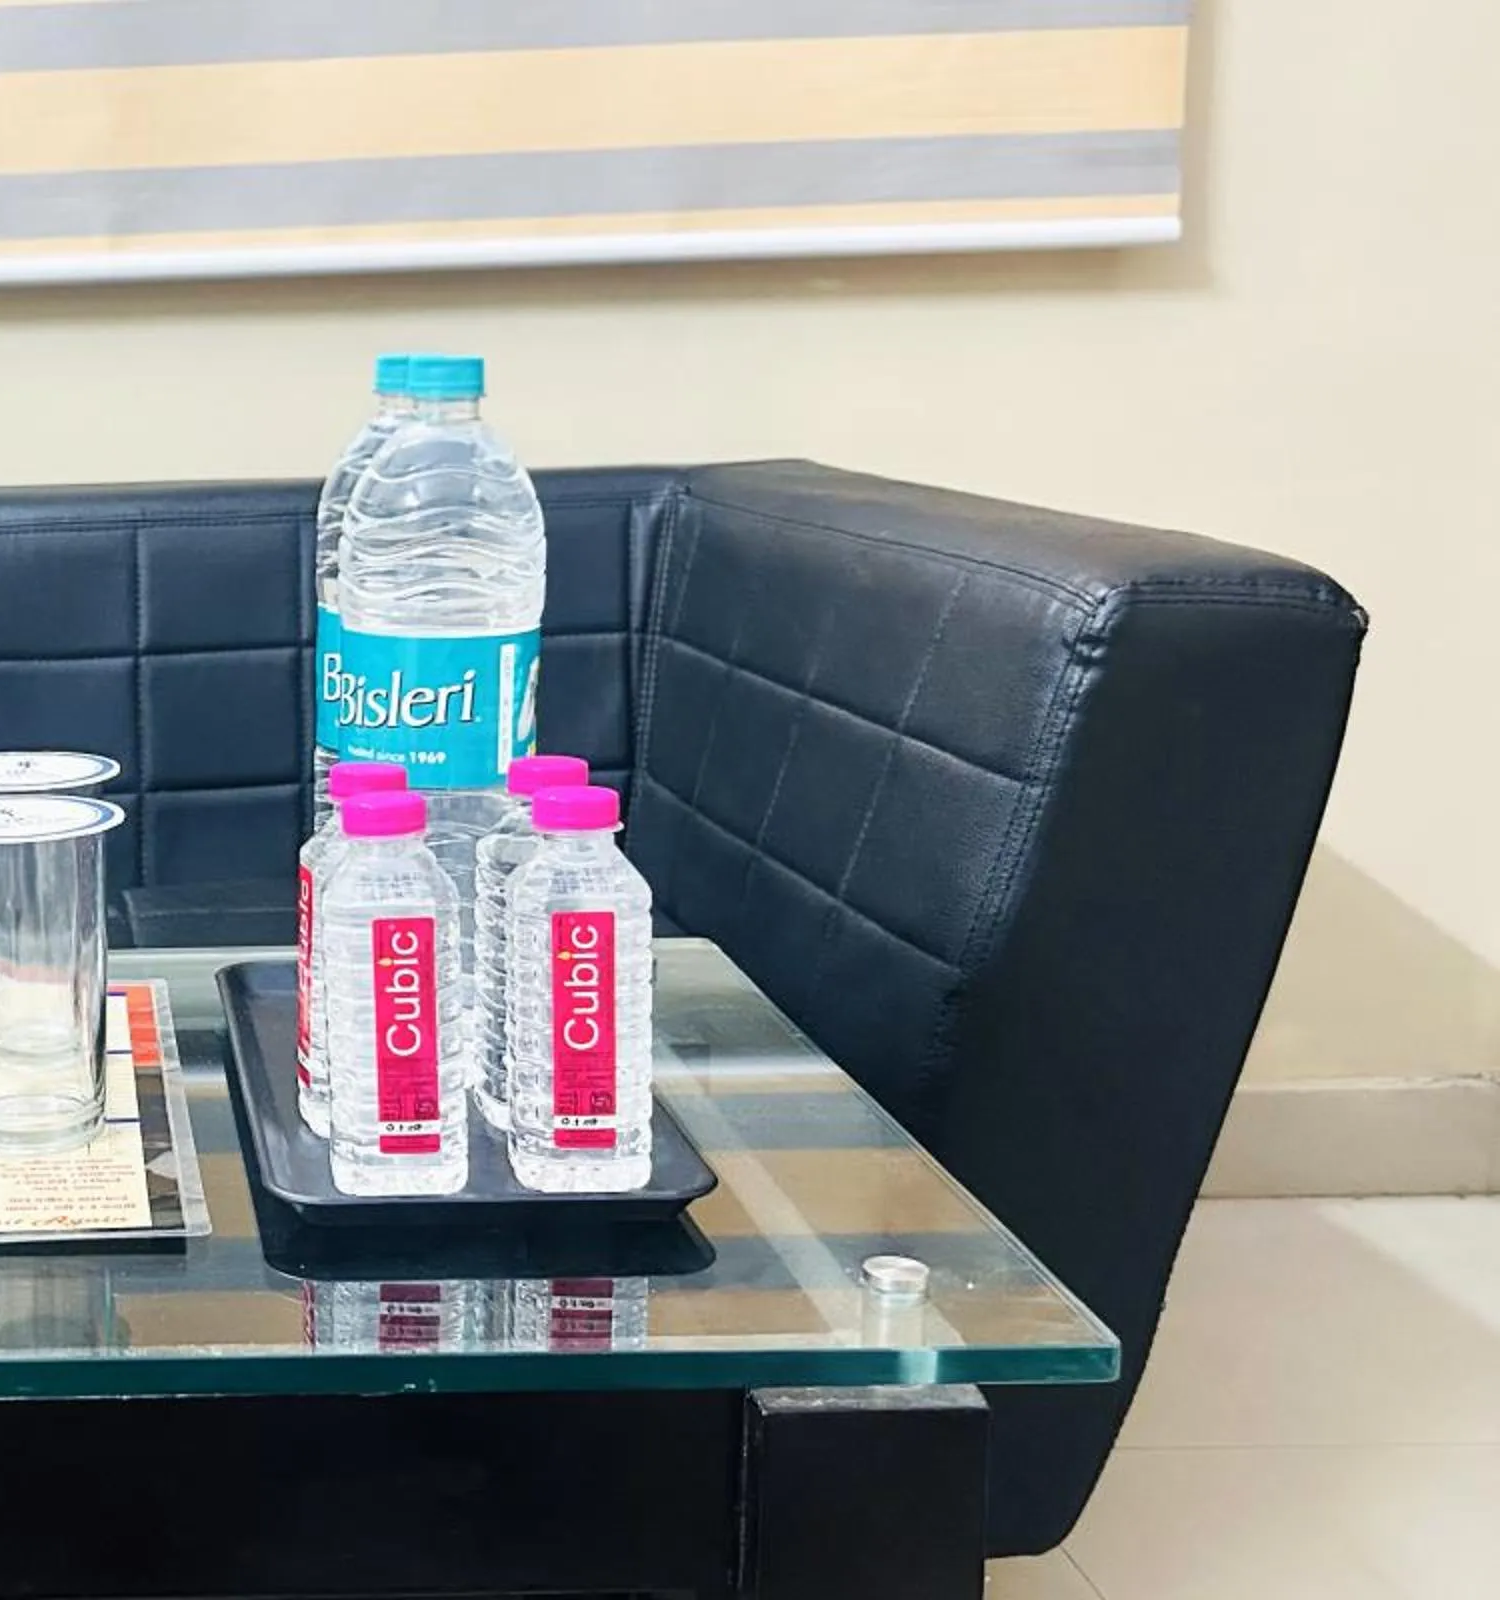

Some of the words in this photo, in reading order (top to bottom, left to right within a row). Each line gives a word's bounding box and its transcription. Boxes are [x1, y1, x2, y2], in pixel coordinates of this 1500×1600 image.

[337, 669, 476, 728] Bisleri
[409, 751, 447, 765] 1969
[377, 931, 421, 1057] Cubic
[557, 924, 600, 1050] Cubic
